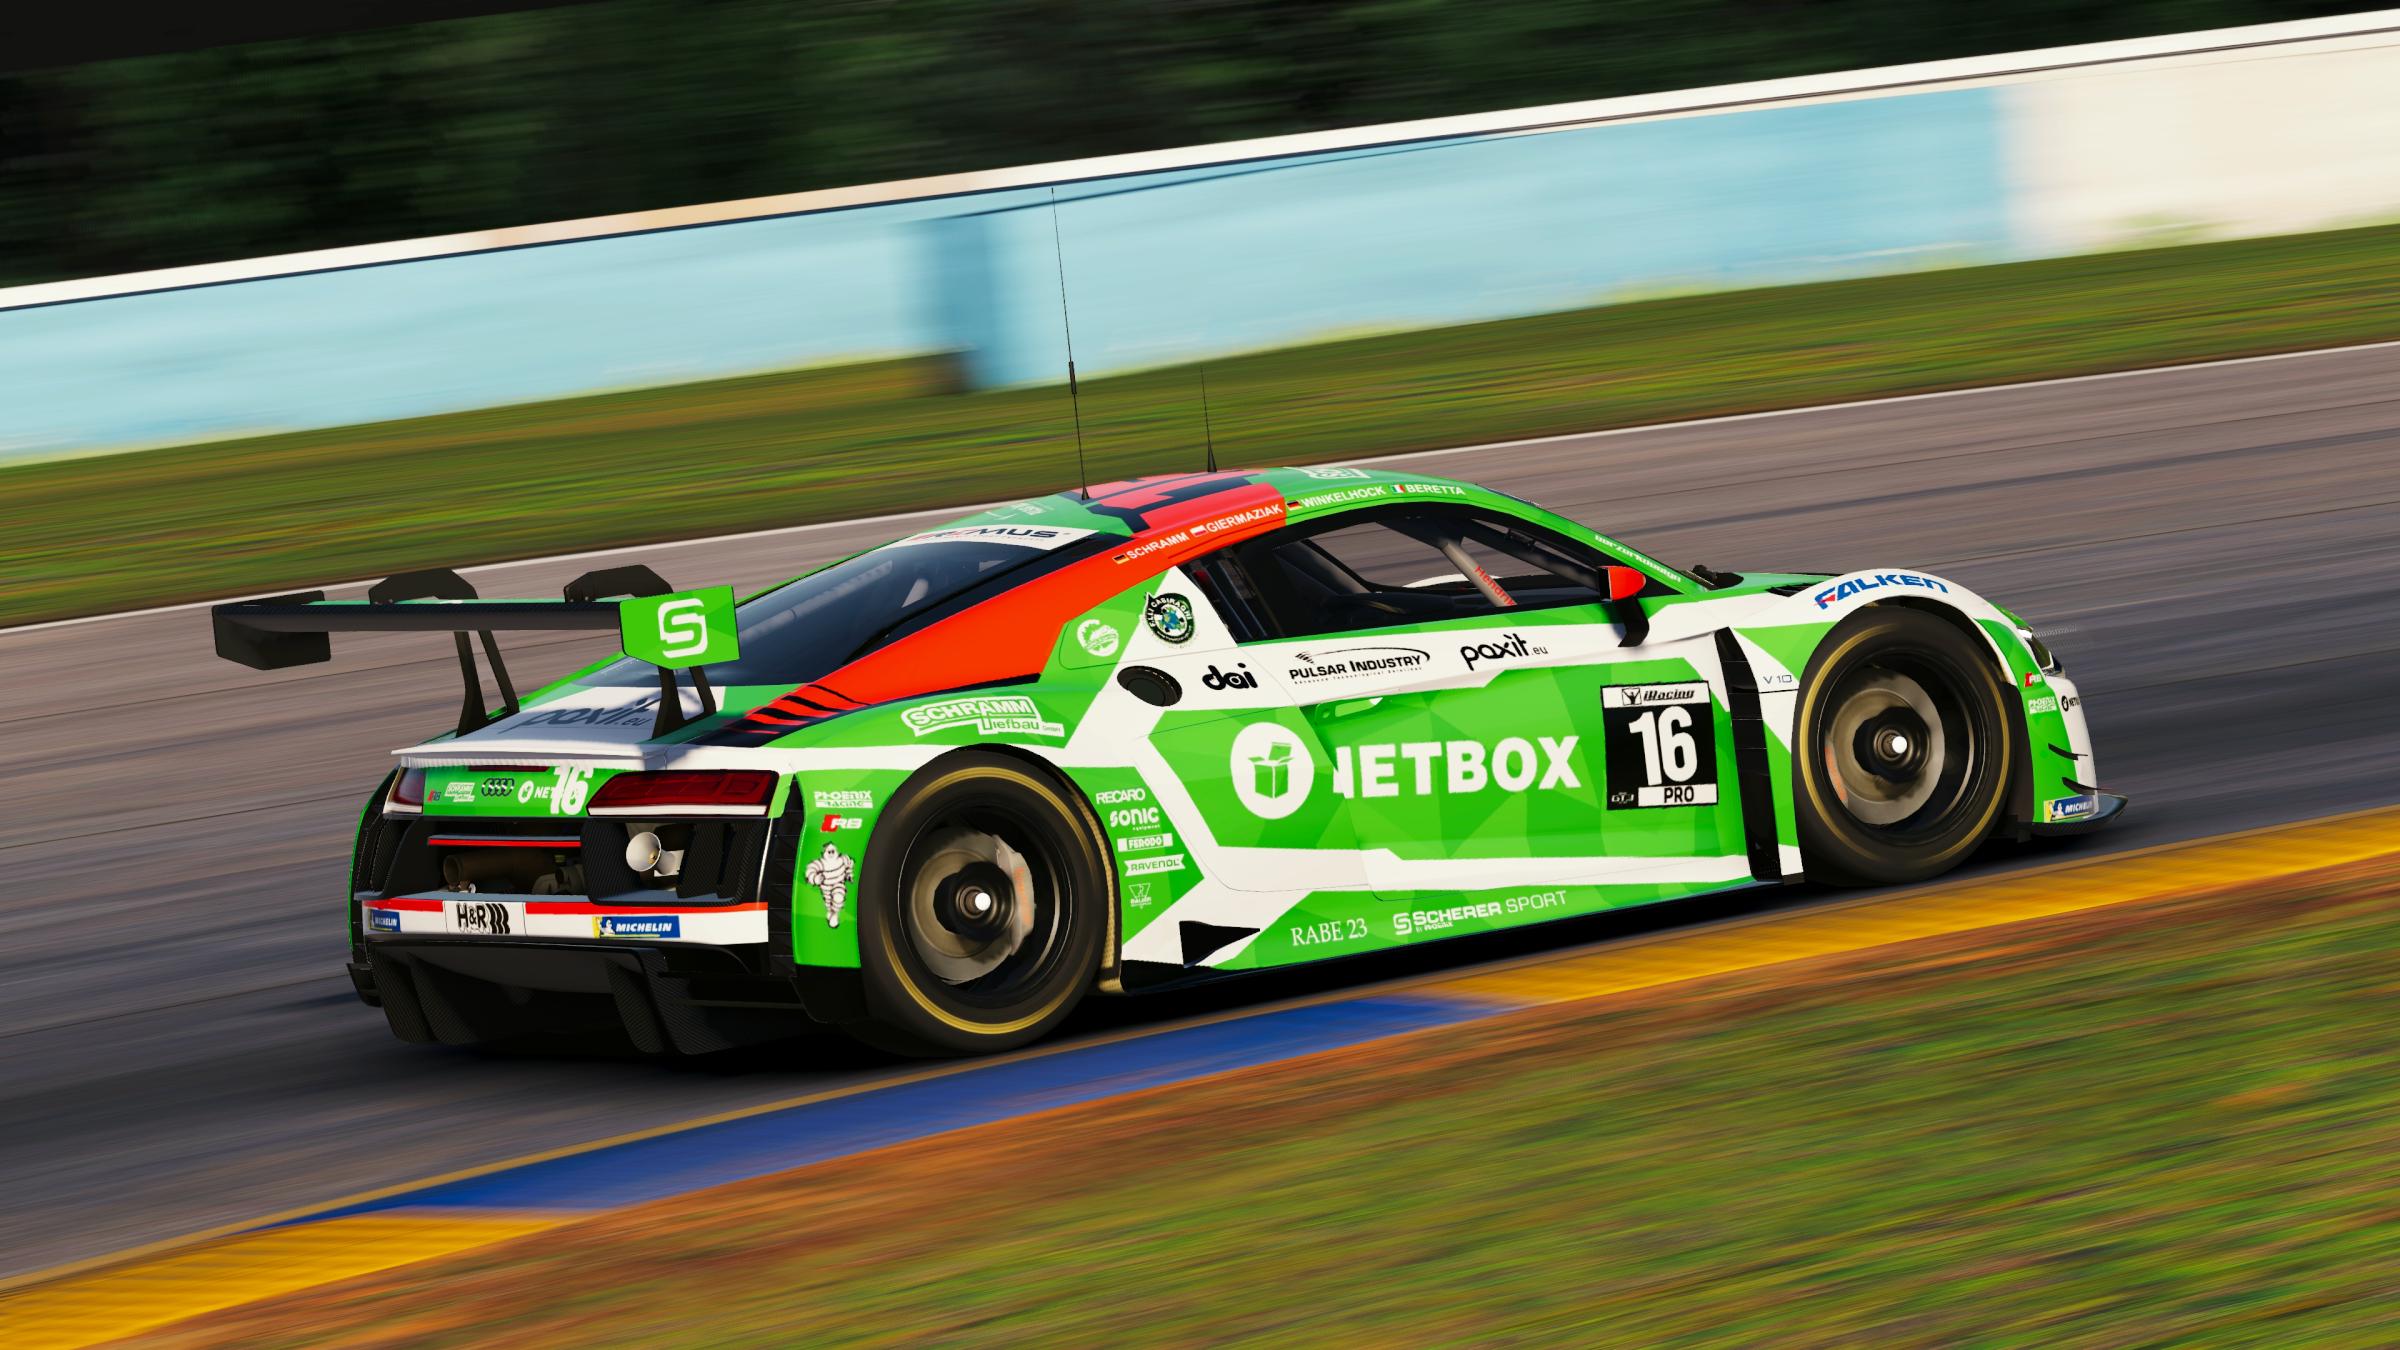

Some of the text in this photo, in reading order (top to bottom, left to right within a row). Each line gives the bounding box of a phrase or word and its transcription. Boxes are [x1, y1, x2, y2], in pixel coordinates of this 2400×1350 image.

[1126, 484, 1466, 560] SCHRAMM GIERMAZIAK WINKELHOCK BERETTA
[1814, 574, 1949, 610] FALKEN
[1202, 661, 1258, 691] dai
[1289, 654, 1422, 681] PULSAR INDUSTRY
[1763, 674, 1793, 685] V 10
[1643, 688, 1696, 702] iRacing
[911, 699, 1032, 726] SCHRAMM
[1628, 705, 1698, 786] 16
[551, 766, 594, 816] 16
[1095, 787, 1146, 804] RECARO
[1663, 785, 1695, 804] PRO
[830, 818, 863, 829] R8
[1128, 836, 1162, 849] FERODO
[1130, 859, 1178, 872] RAVENOL
[456, 903, 488, 929] H&R
[1412, 901, 1502, 926] SCHERER
[1505, 890, 1567, 913] SPORT
[373, 917, 398, 928] MICHELIN
[615, 922, 673, 933] MICHELIN
[1290, 917, 1368, 947] RABE 23
